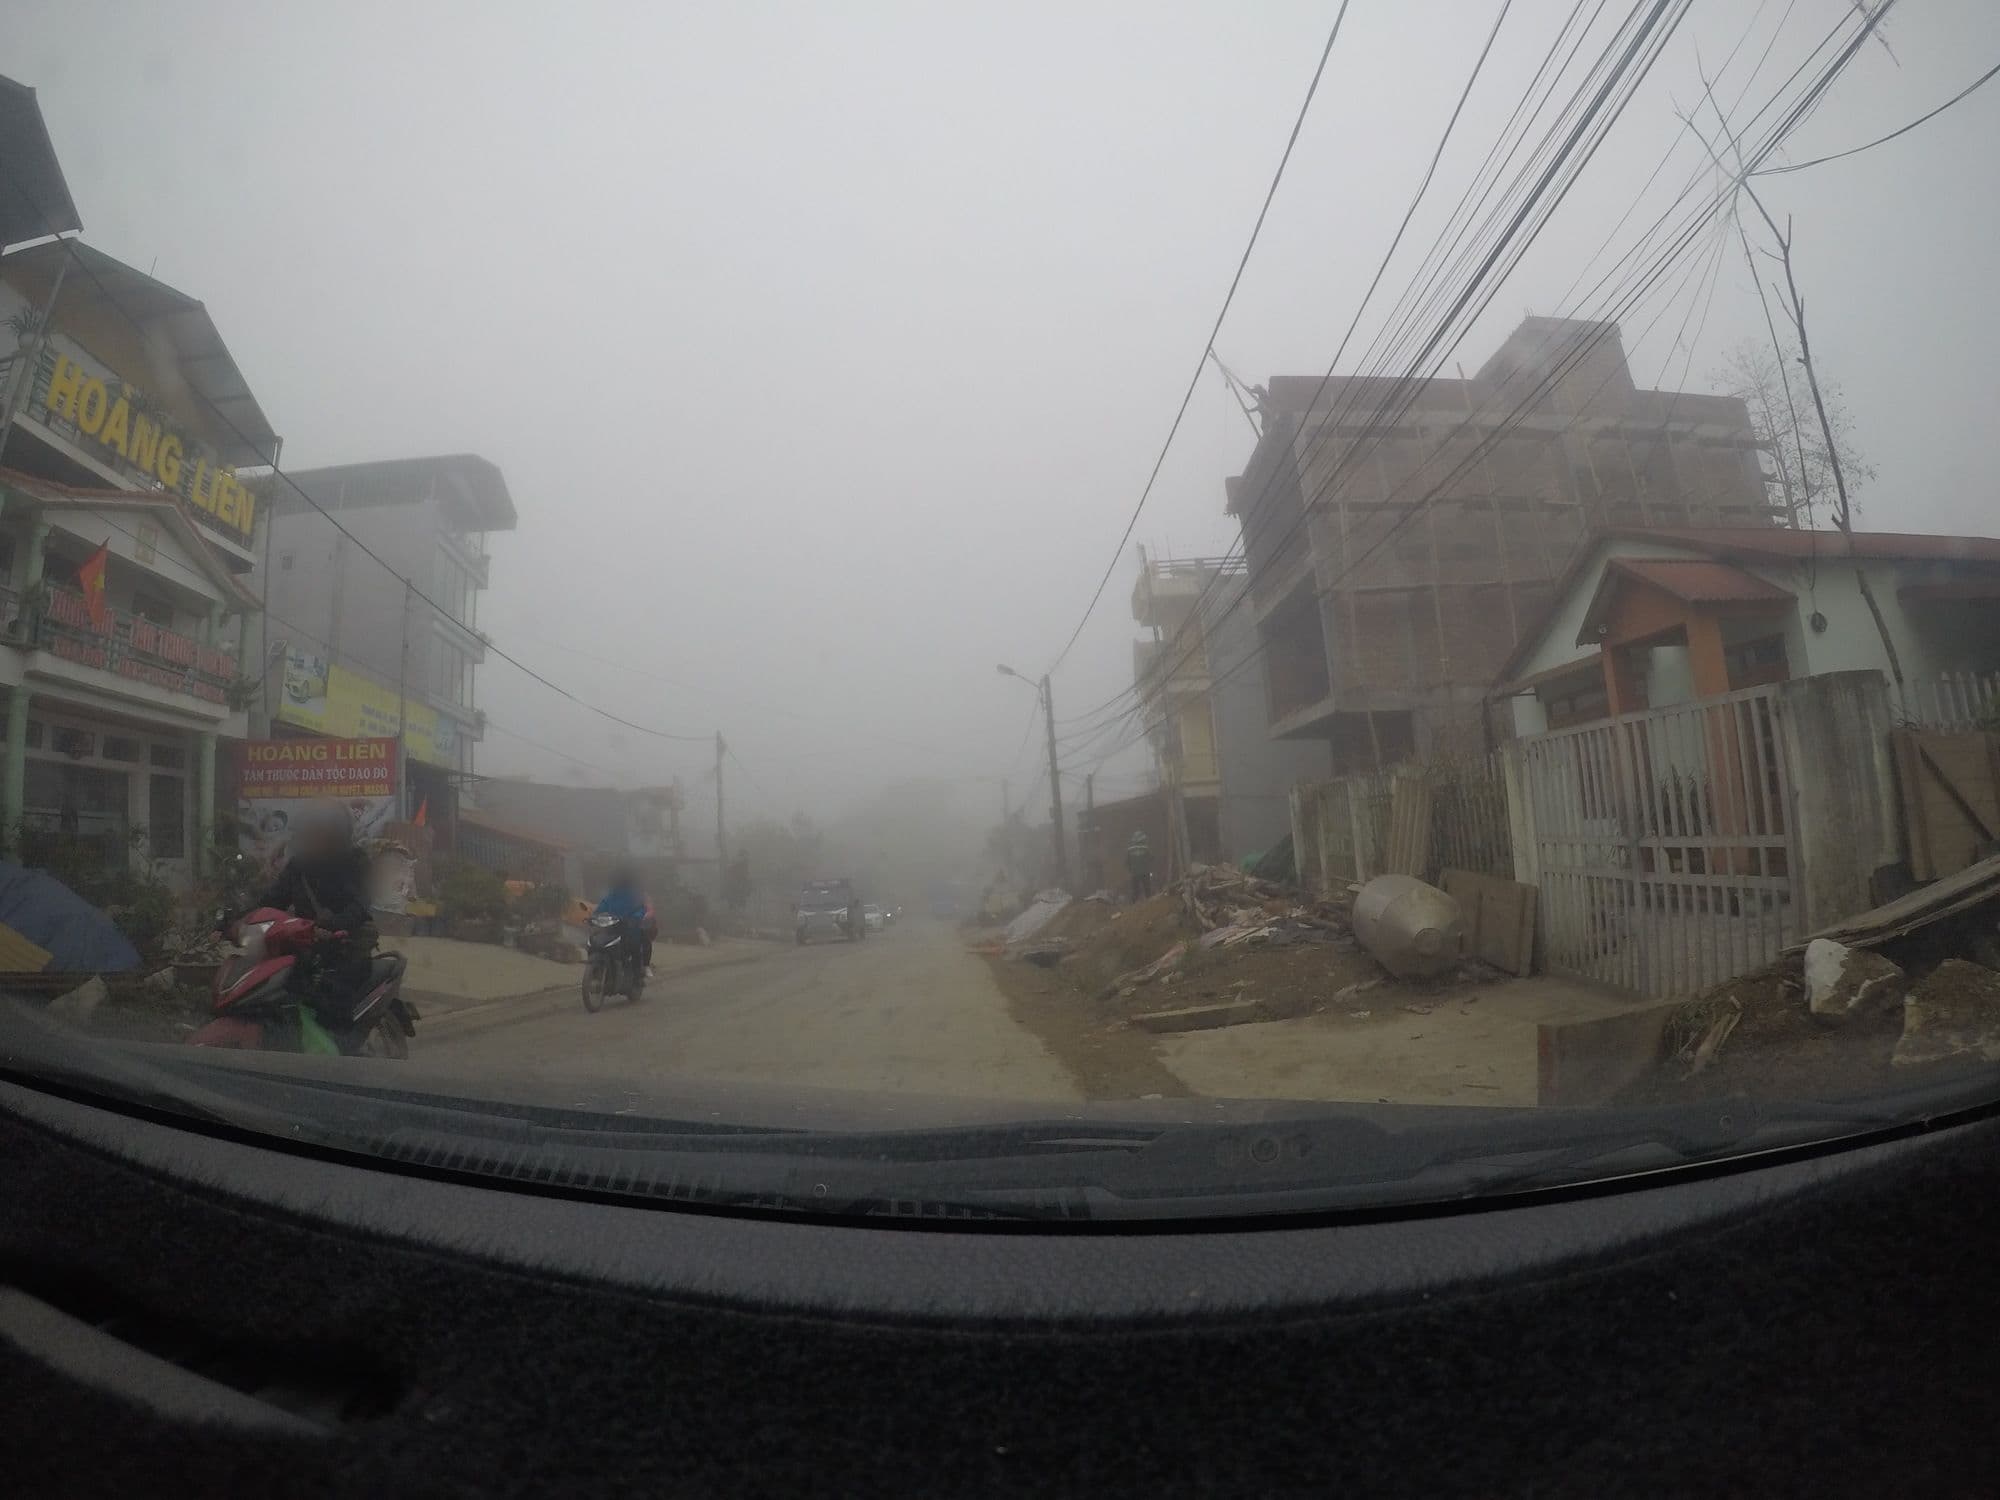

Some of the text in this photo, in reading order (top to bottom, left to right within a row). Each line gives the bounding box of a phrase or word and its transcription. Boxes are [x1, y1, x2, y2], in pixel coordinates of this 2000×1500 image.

[47, 353, 256, 535] HOÀNG LIÊN
[247, 740, 386, 761] HOÀNG LIÊN
[348, 767, 371, 779] DAO
